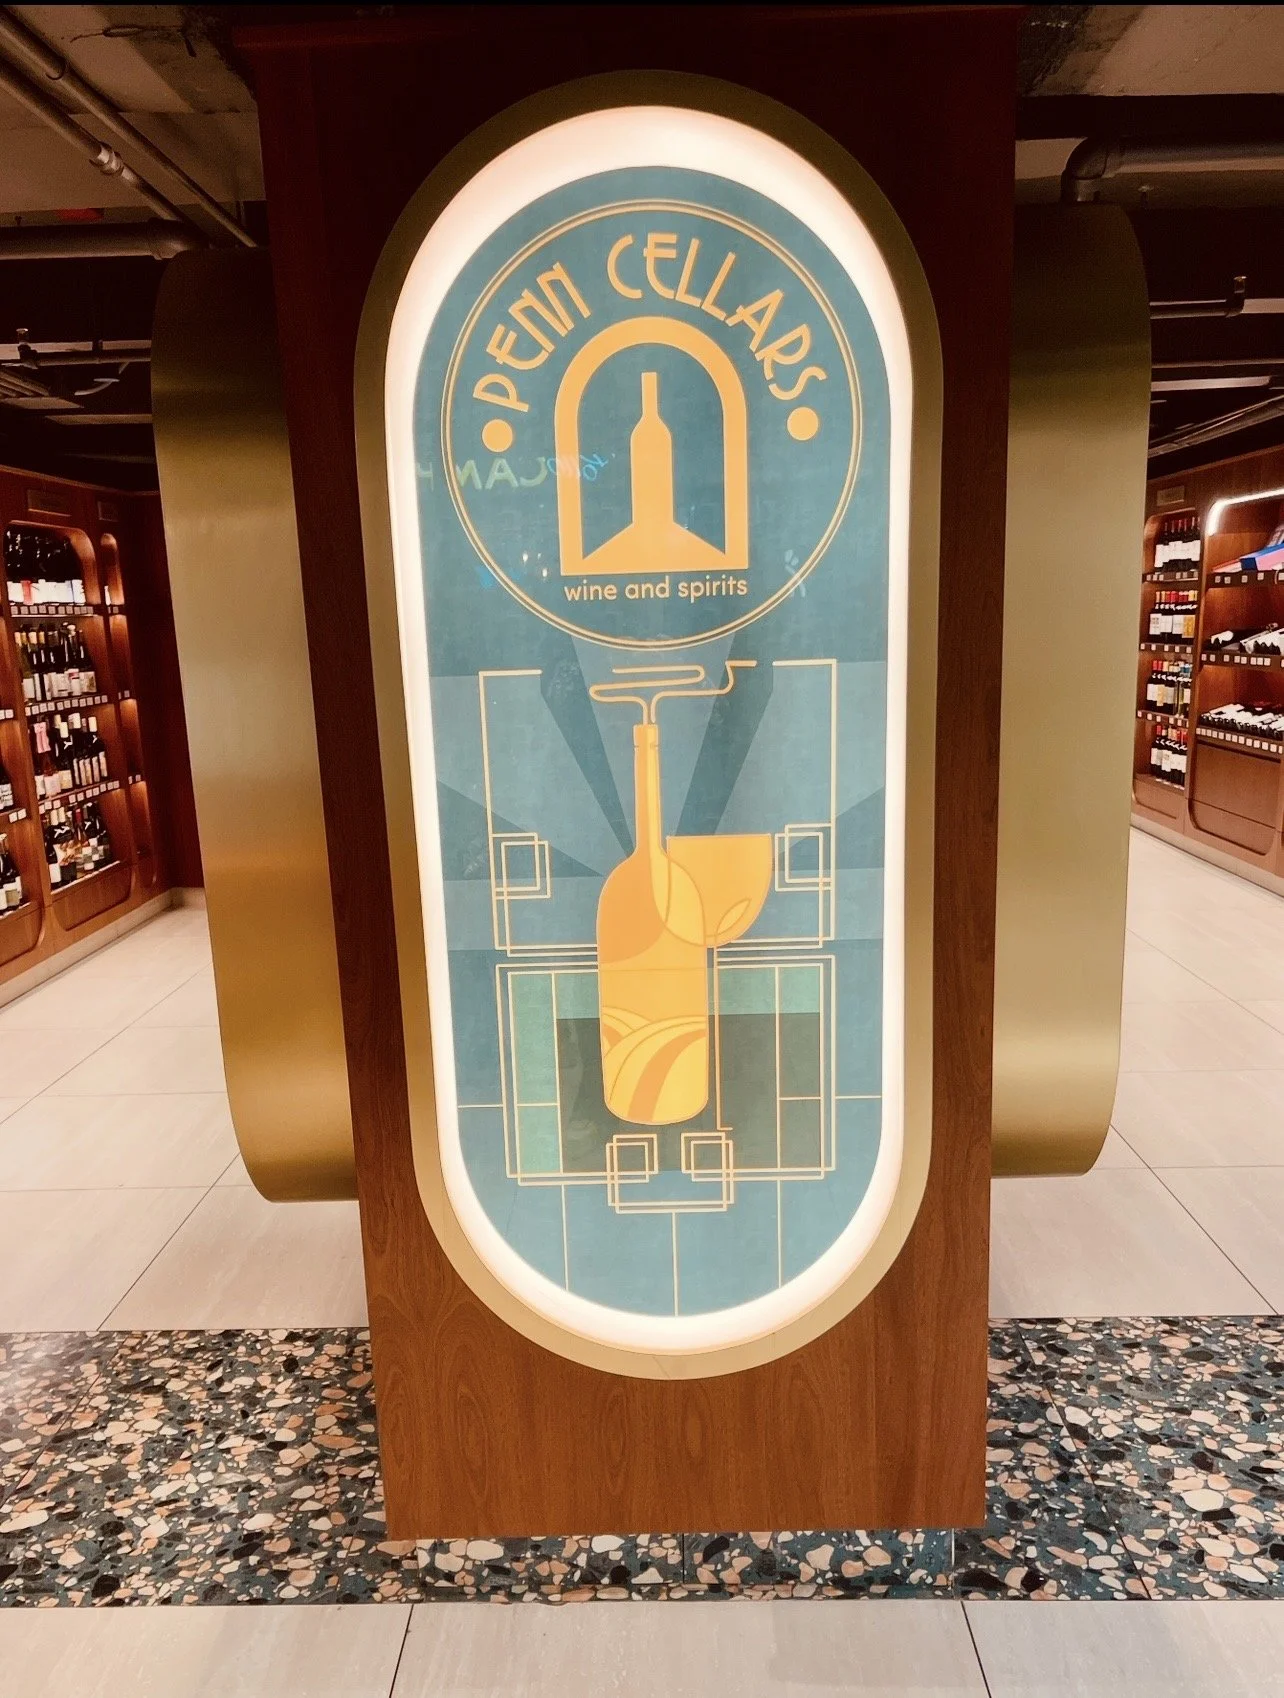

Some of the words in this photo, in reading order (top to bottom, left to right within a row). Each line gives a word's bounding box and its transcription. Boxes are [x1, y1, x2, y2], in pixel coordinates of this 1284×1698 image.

[472, 261, 591, 413] PENN
[606, 232, 826, 401] CELLARS
[564, 579, 617, 601] wine
[624, 575, 670, 599] and
[677, 574, 748, 603] spirits
